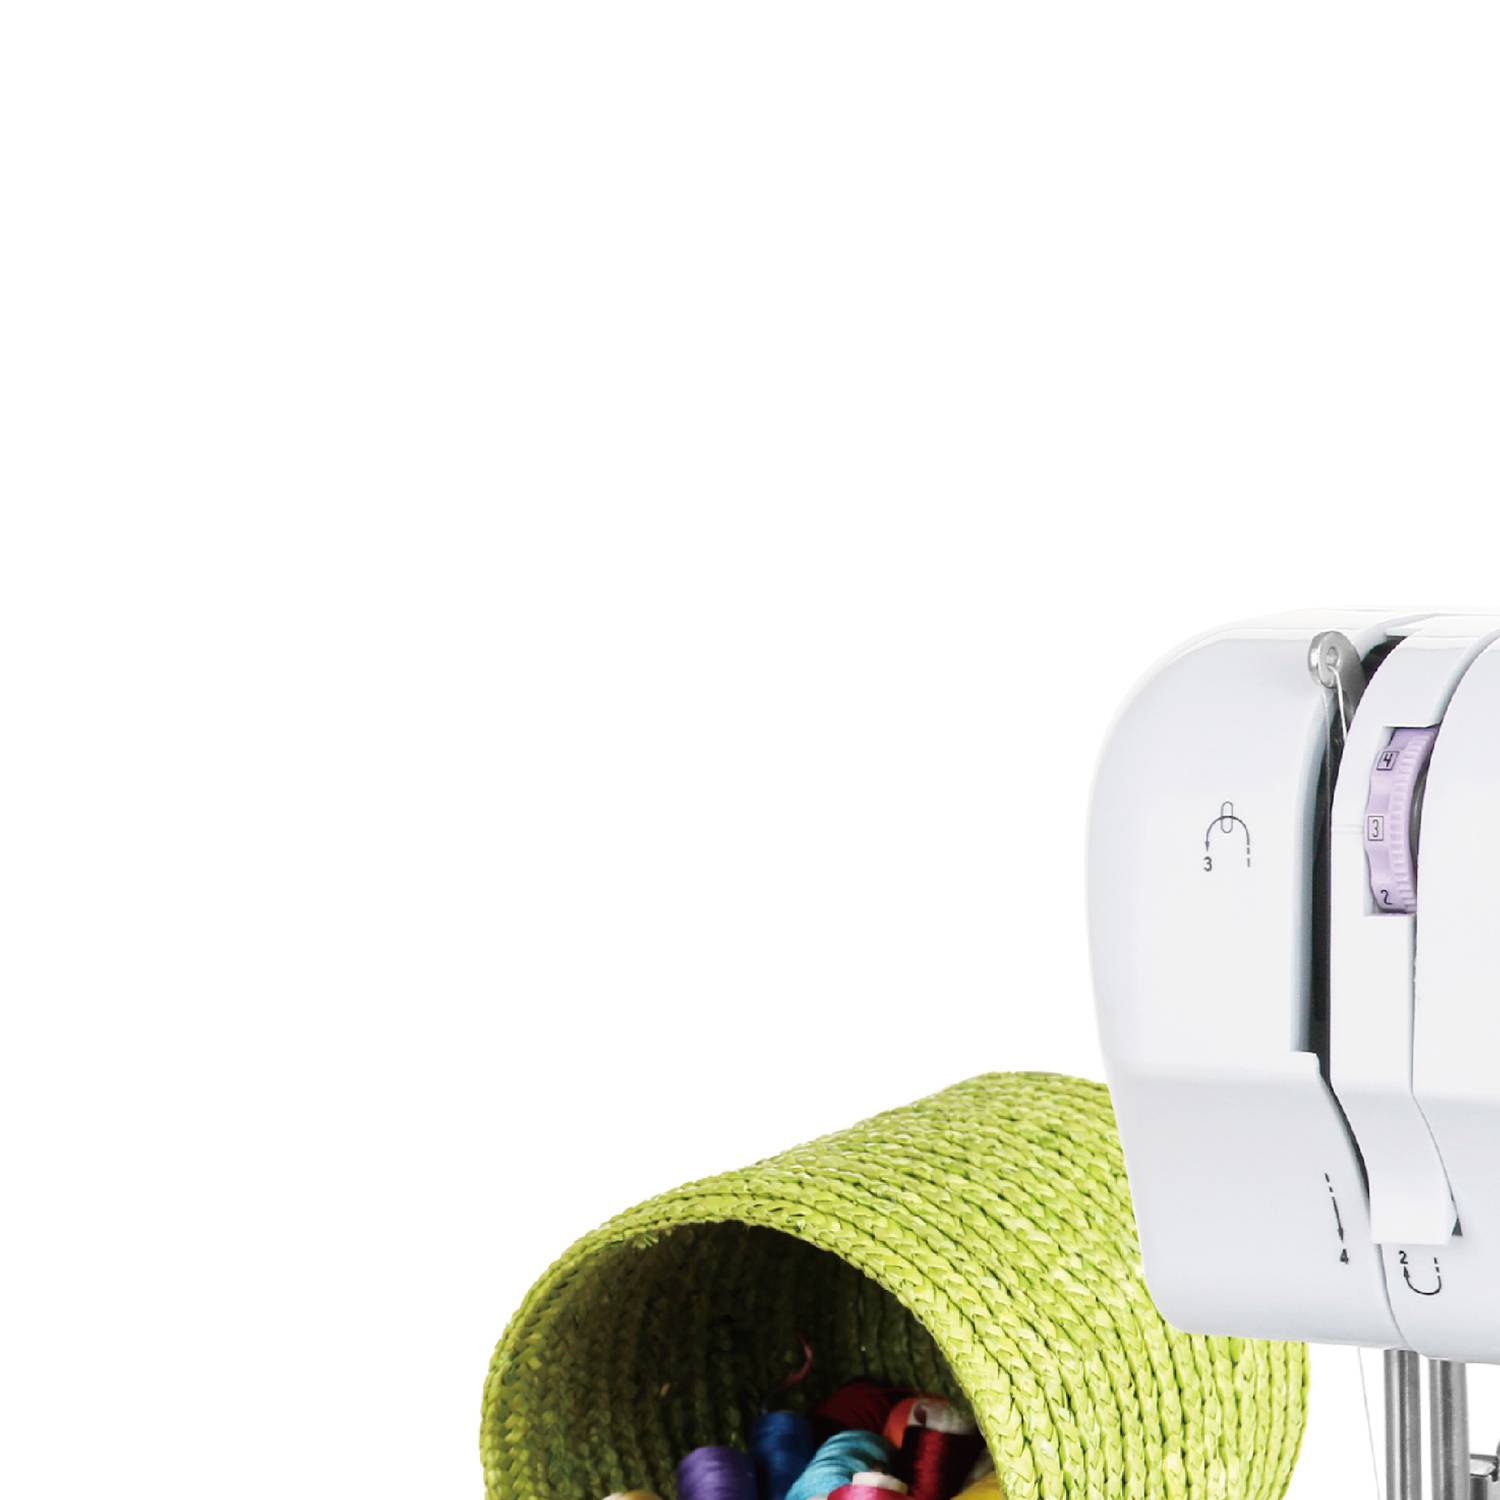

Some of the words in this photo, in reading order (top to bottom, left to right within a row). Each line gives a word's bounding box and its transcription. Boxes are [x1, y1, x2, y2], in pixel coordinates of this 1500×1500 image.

[1381, 752, 1395, 769] 4
[1370, 818, 1380, 839] 3
[1203, 856, 1213, 872] 3
[1380, 888, 1393, 906] 2
[1398, 1249, 1409, 1265] 2
